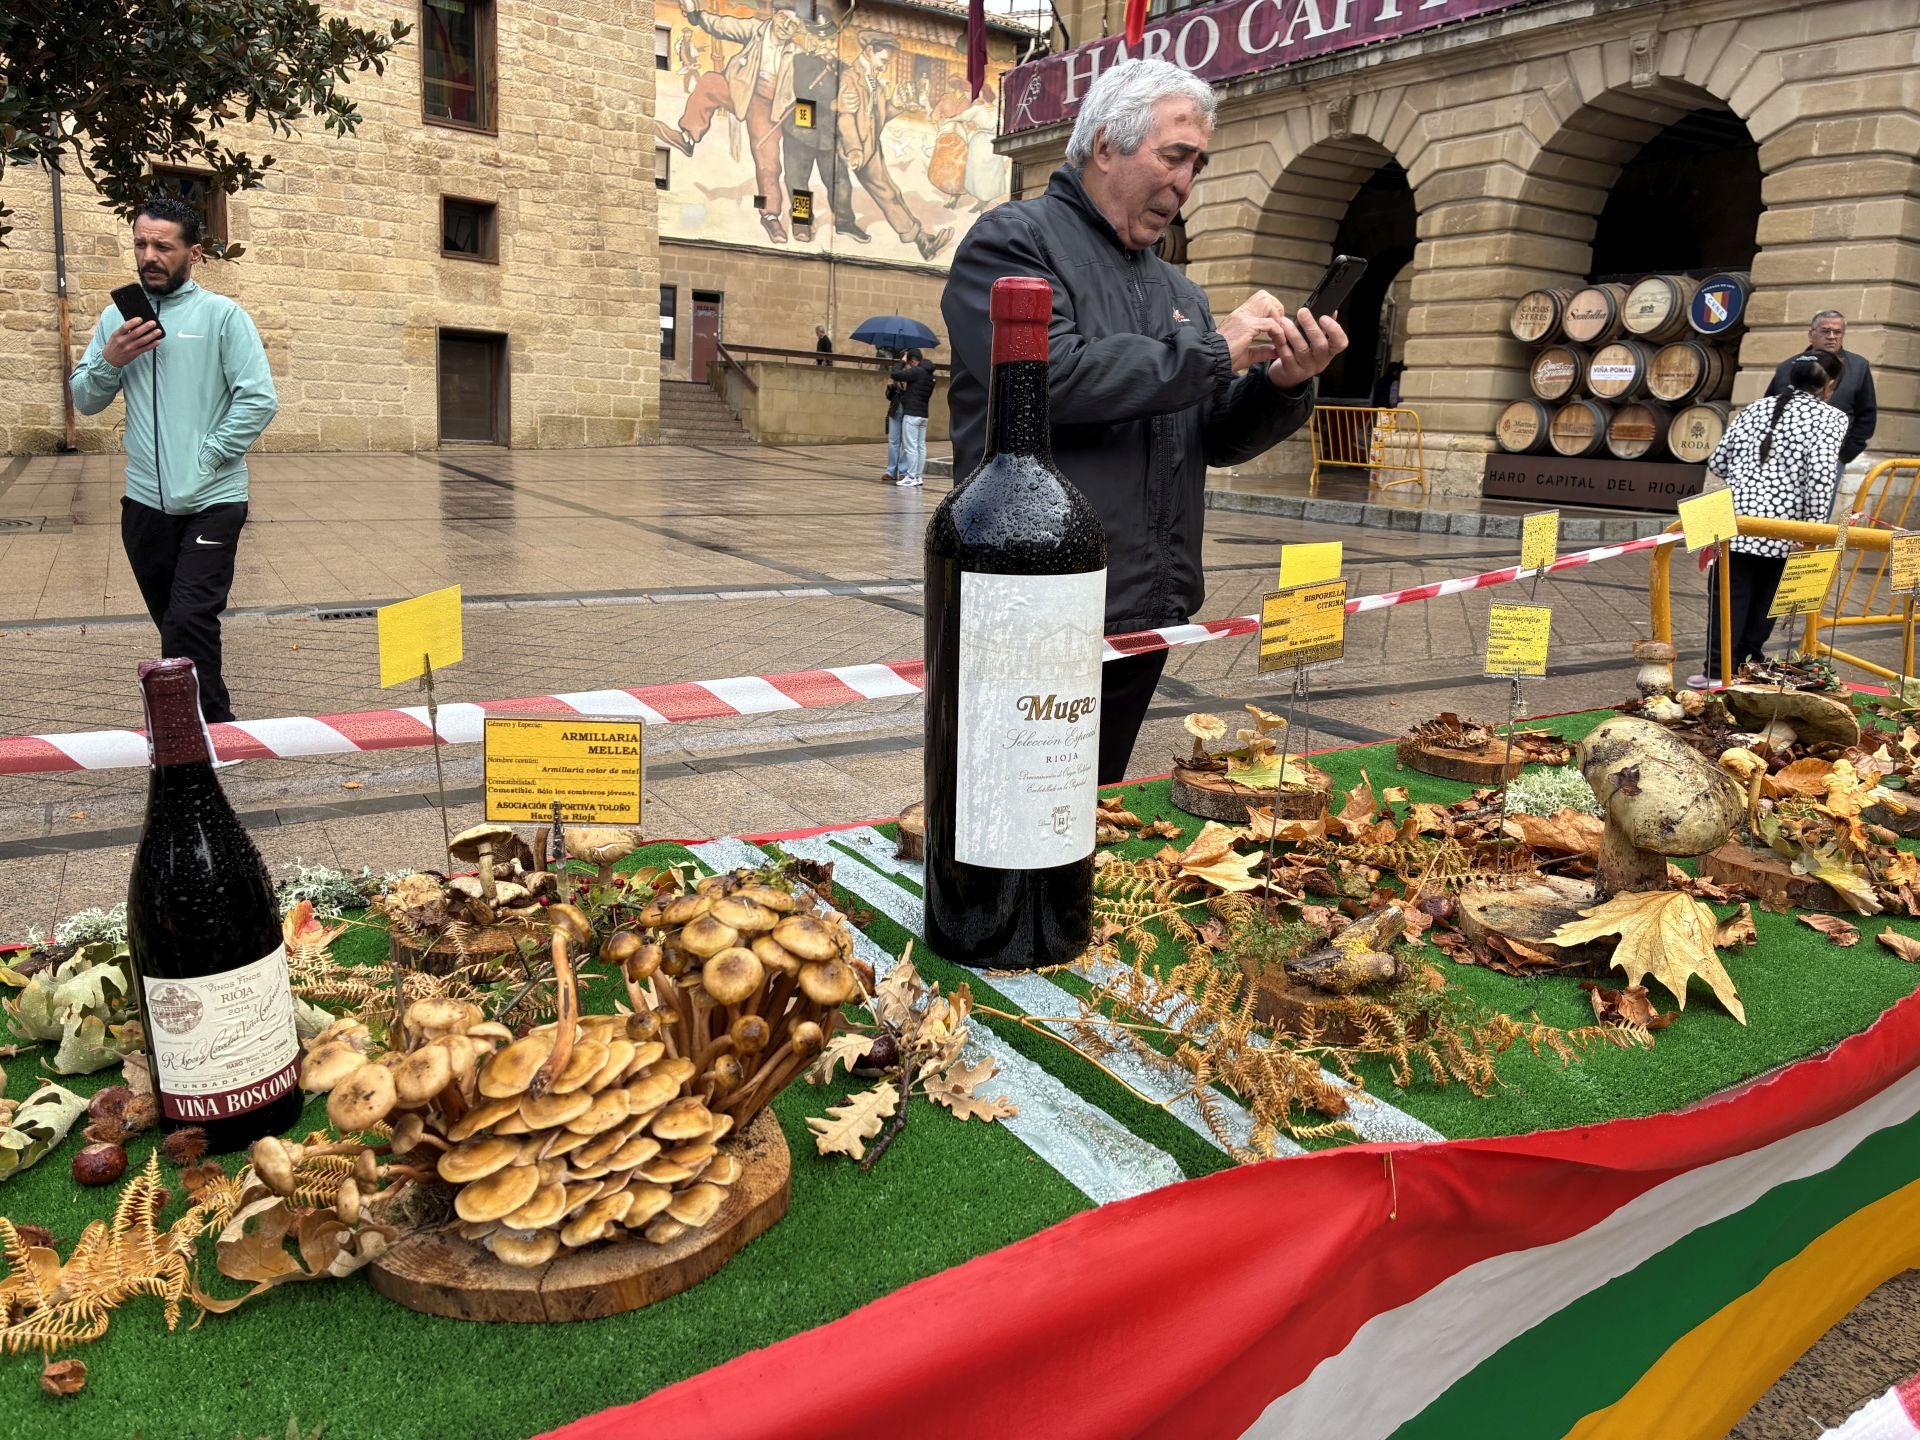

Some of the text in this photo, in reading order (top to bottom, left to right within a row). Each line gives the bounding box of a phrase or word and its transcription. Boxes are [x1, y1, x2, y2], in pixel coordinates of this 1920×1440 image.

[1521, 305, 1550, 313] CARLOS
[1680, 440, 1710, 450] RODA
[1489, 470, 1697, 495] HARO CAPITAL DEL RIOJA
[1016, 694, 1097, 724] Muga
[487, 721, 511, 729] Género
[561, 732, 639, 743] ARMILLARIA
[1002, 728, 1061, 750] Selección
[588, 745, 639, 756] MELLEA
[1046, 752, 1078, 764] RIOJA
[542, 766, 584, 774] Armillaria
[621, 767, 640, 775] miel
[487, 786, 535, 795] Comestible.
[496, 801, 631, 812] ASOCIACIÓN DPORTIVA TOLOÑO
[530, 812, 553, 820] Haro
[572, 812, 596, 821] Rioja
[220, 987, 255, 1004] RIOJA
[228, 1004, 250, 1016] 2014
[174, 1076, 238, 1089] FUNDADA
[250, 1067, 265, 1077] EN
[174, 1095, 221, 1118] VIÑA
[227, 1064, 298, 1114] BOSCONIA
